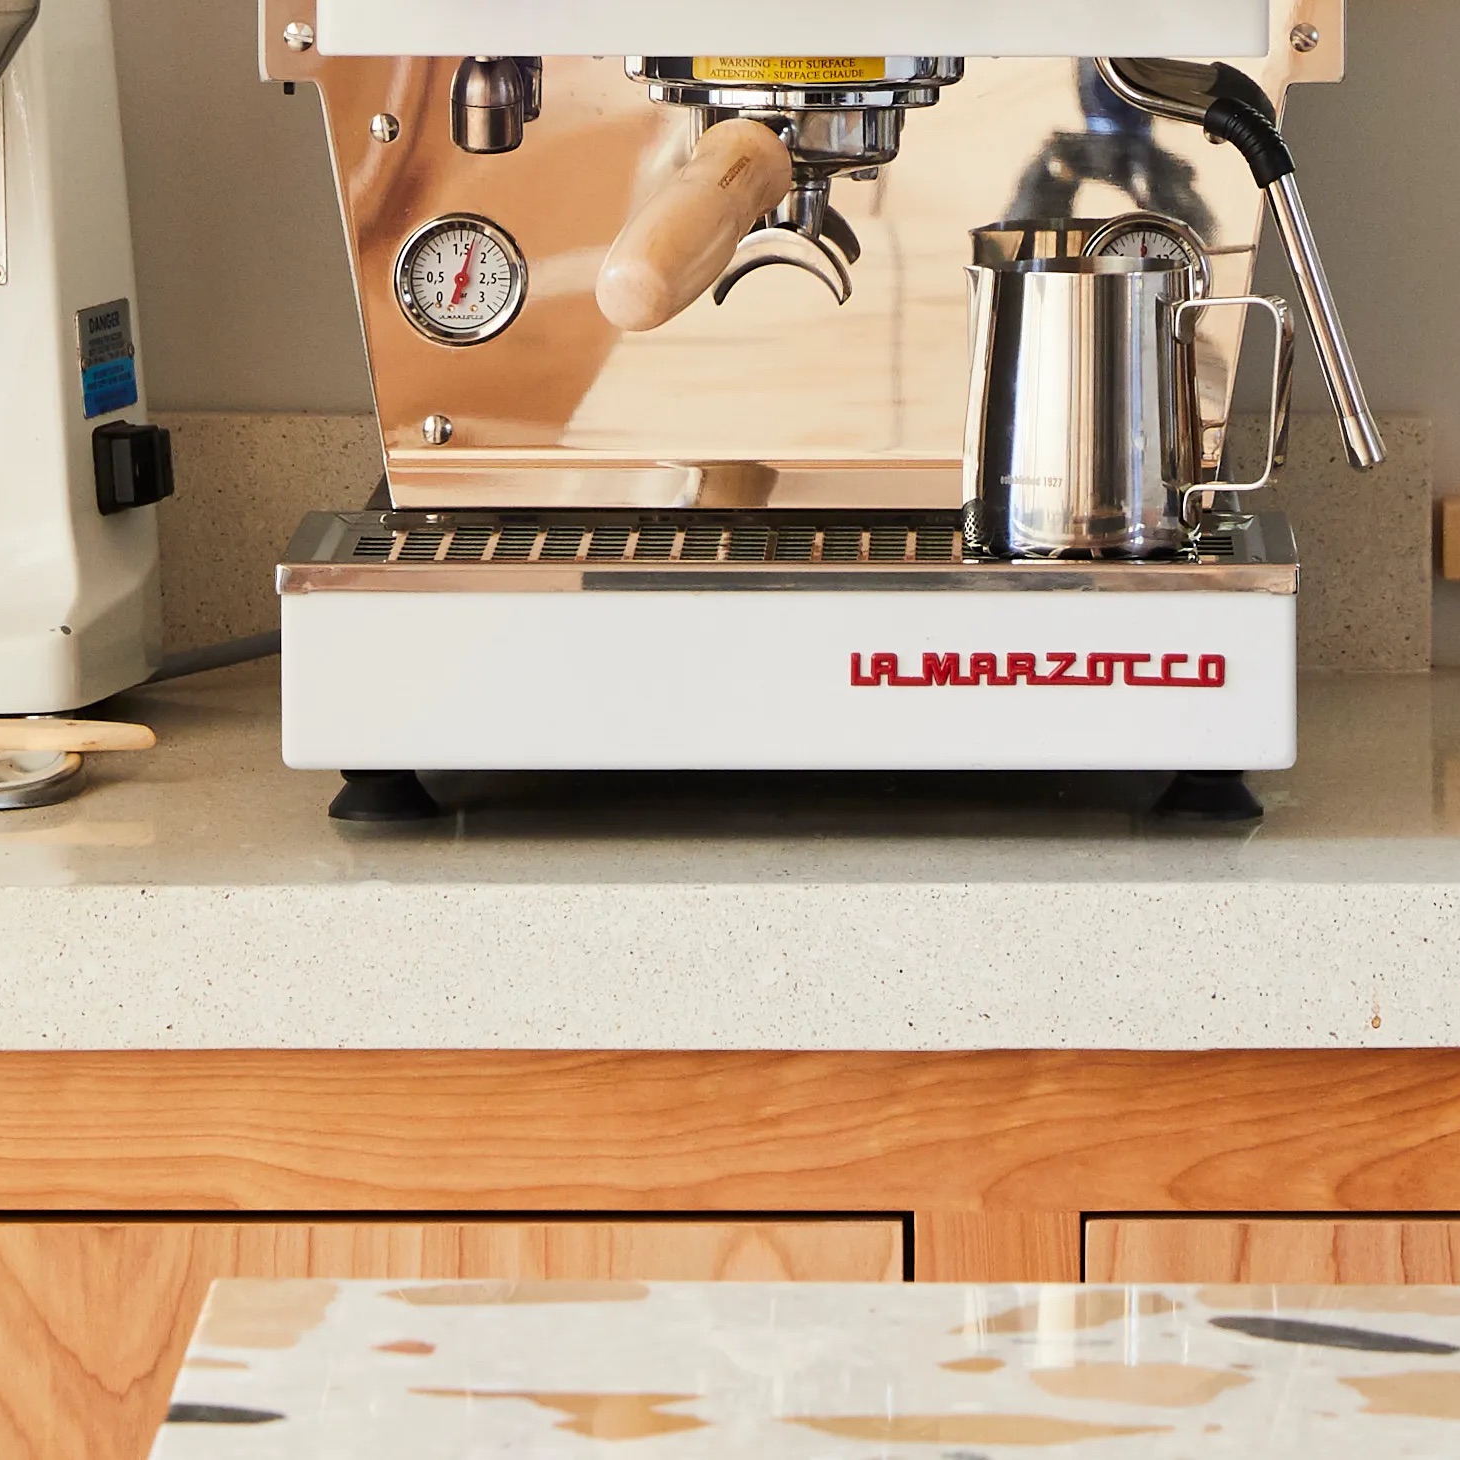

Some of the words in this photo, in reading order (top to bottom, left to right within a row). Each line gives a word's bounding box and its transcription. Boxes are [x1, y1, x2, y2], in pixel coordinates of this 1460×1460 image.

[719, 57, 770, 69] WARNING
[780, 59, 804, 69] HOT
[806, 57, 856, 69] SURFACE
[710, 69, 765, 79] ATTENTION
[773, 70, 821, 80] SURFACE
[823, 69, 865, 79] CHAUDE
[452, 243, 470, 257] 1,5
[436, 252, 442, 264] 1
[480, 252, 487, 264] 2
[426, 271, 444, 285] 0,5
[479, 272, 497, 286] 2,5
[436, 291, 443, 303] 0
[478, 291, 485, 303] 3
[88, 310, 121, 334] DANGER
[1043, 476, 1063, 488] 1927
[850, 652, 899, 687] LA
